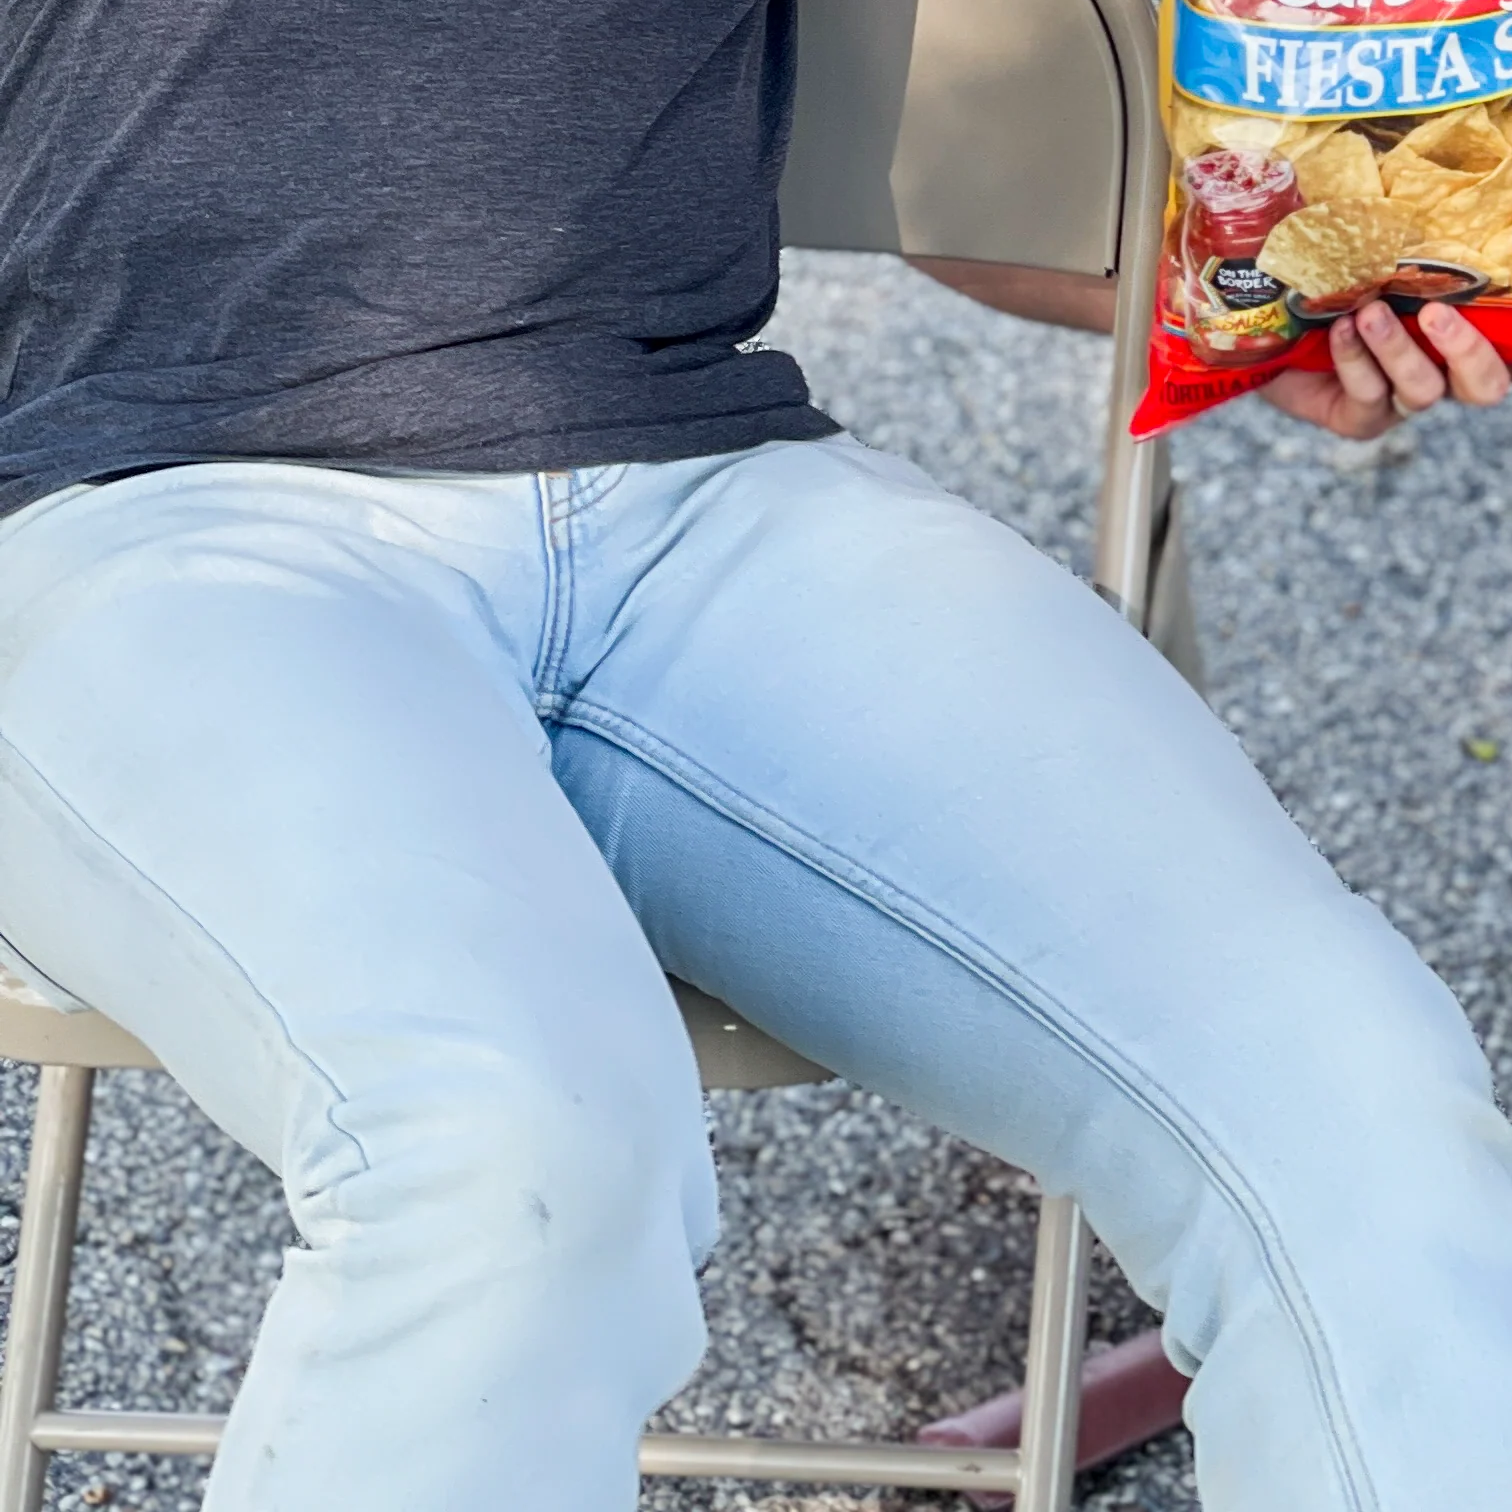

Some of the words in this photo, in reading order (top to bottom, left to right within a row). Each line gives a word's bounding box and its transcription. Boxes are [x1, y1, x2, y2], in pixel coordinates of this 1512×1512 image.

[1242, 31, 1481, 109] FIESTA
[1218, 275, 1278, 292] BORDER
[1219, 269, 1236, 278] ON
[1237, 269, 1263, 278] THE
[1223, 307, 1279, 330] SALSA
